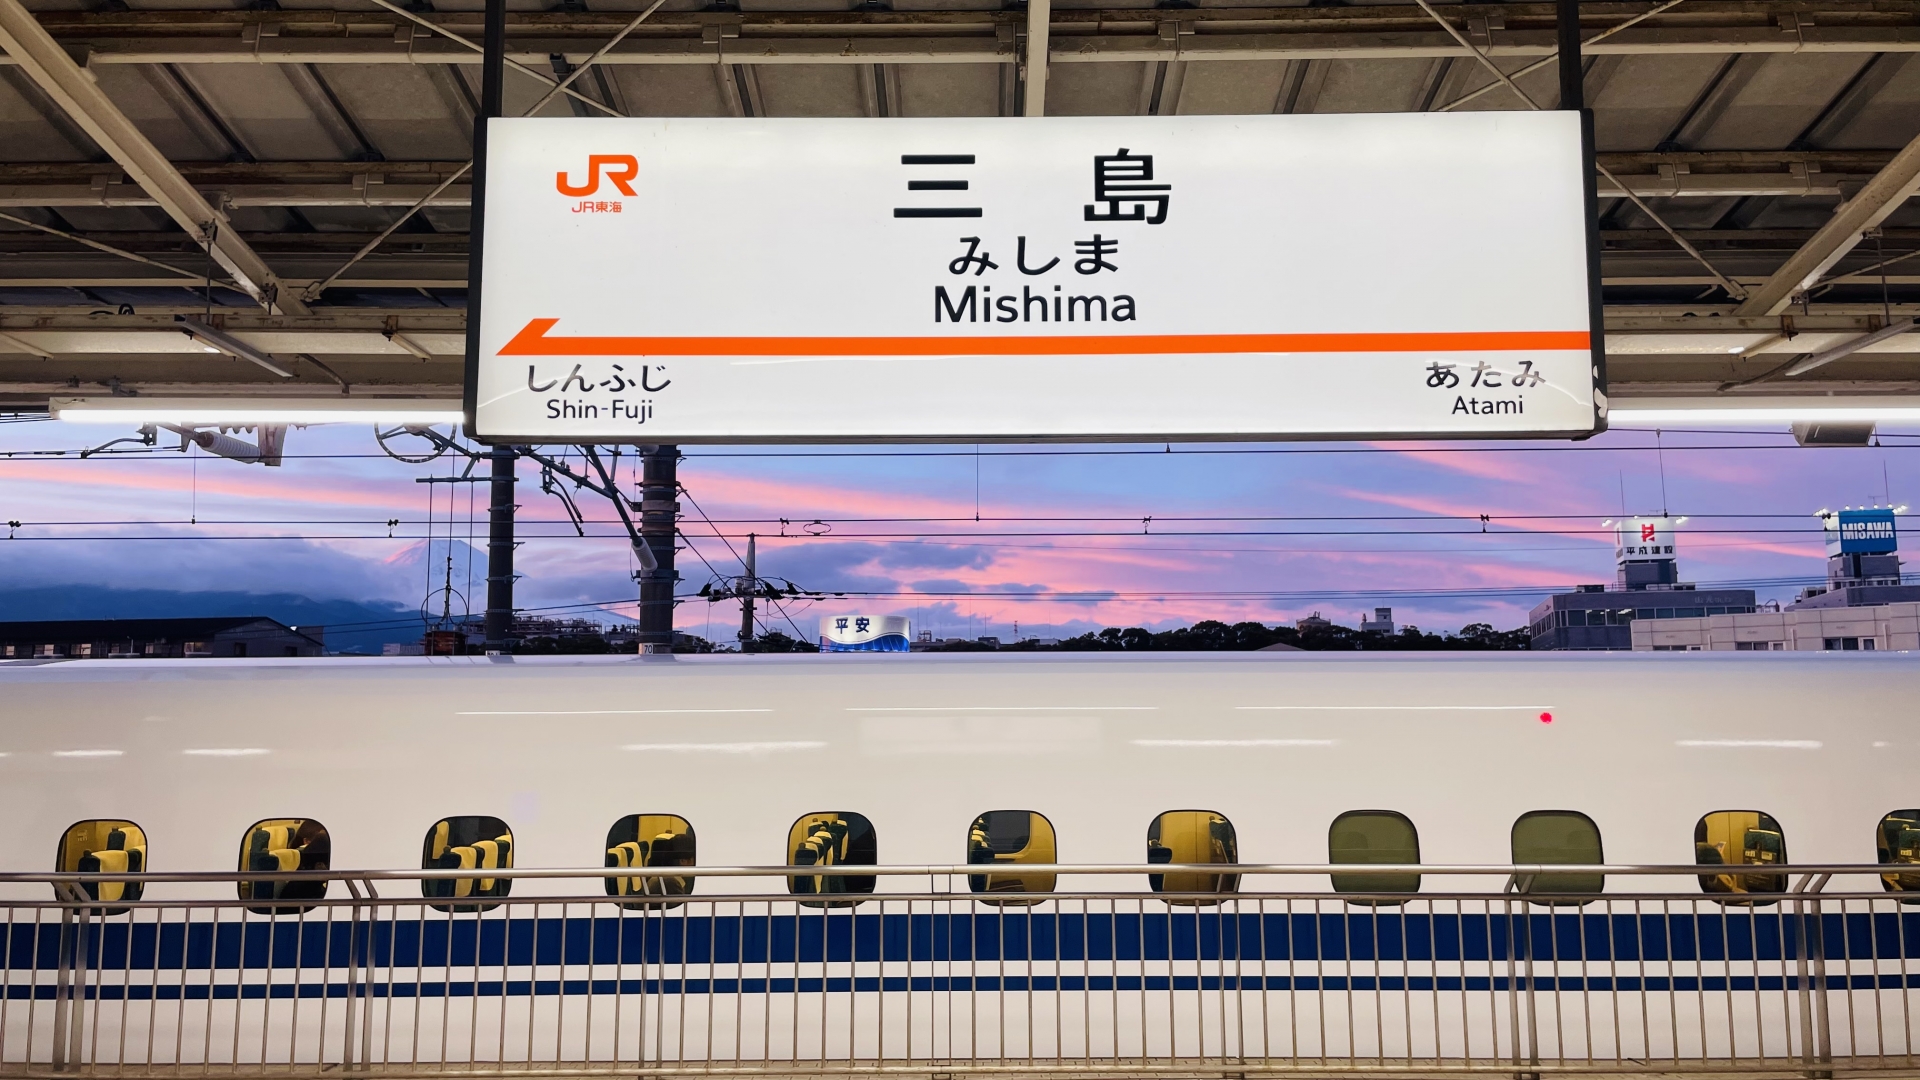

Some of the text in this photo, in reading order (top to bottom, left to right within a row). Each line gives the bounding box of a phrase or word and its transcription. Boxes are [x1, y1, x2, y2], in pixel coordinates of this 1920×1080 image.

[556, 154, 639, 197] JR
[893, 148, 1173, 226] 三島
[571, 200, 623, 214] JR東海
[949, 234, 1120, 278] みしま
[935, 285, 1138, 324] Mishima
[528, 363, 672, 394] しんふじ
[1425, 361, 1547, 390] あたみ
[546, 399, 654, 425] Shin-Fuji
[1451, 395, 1525, 416] Atami
[1841, 521, 1895, 541] MISAWA
[835, 616, 870, 634] 平安
